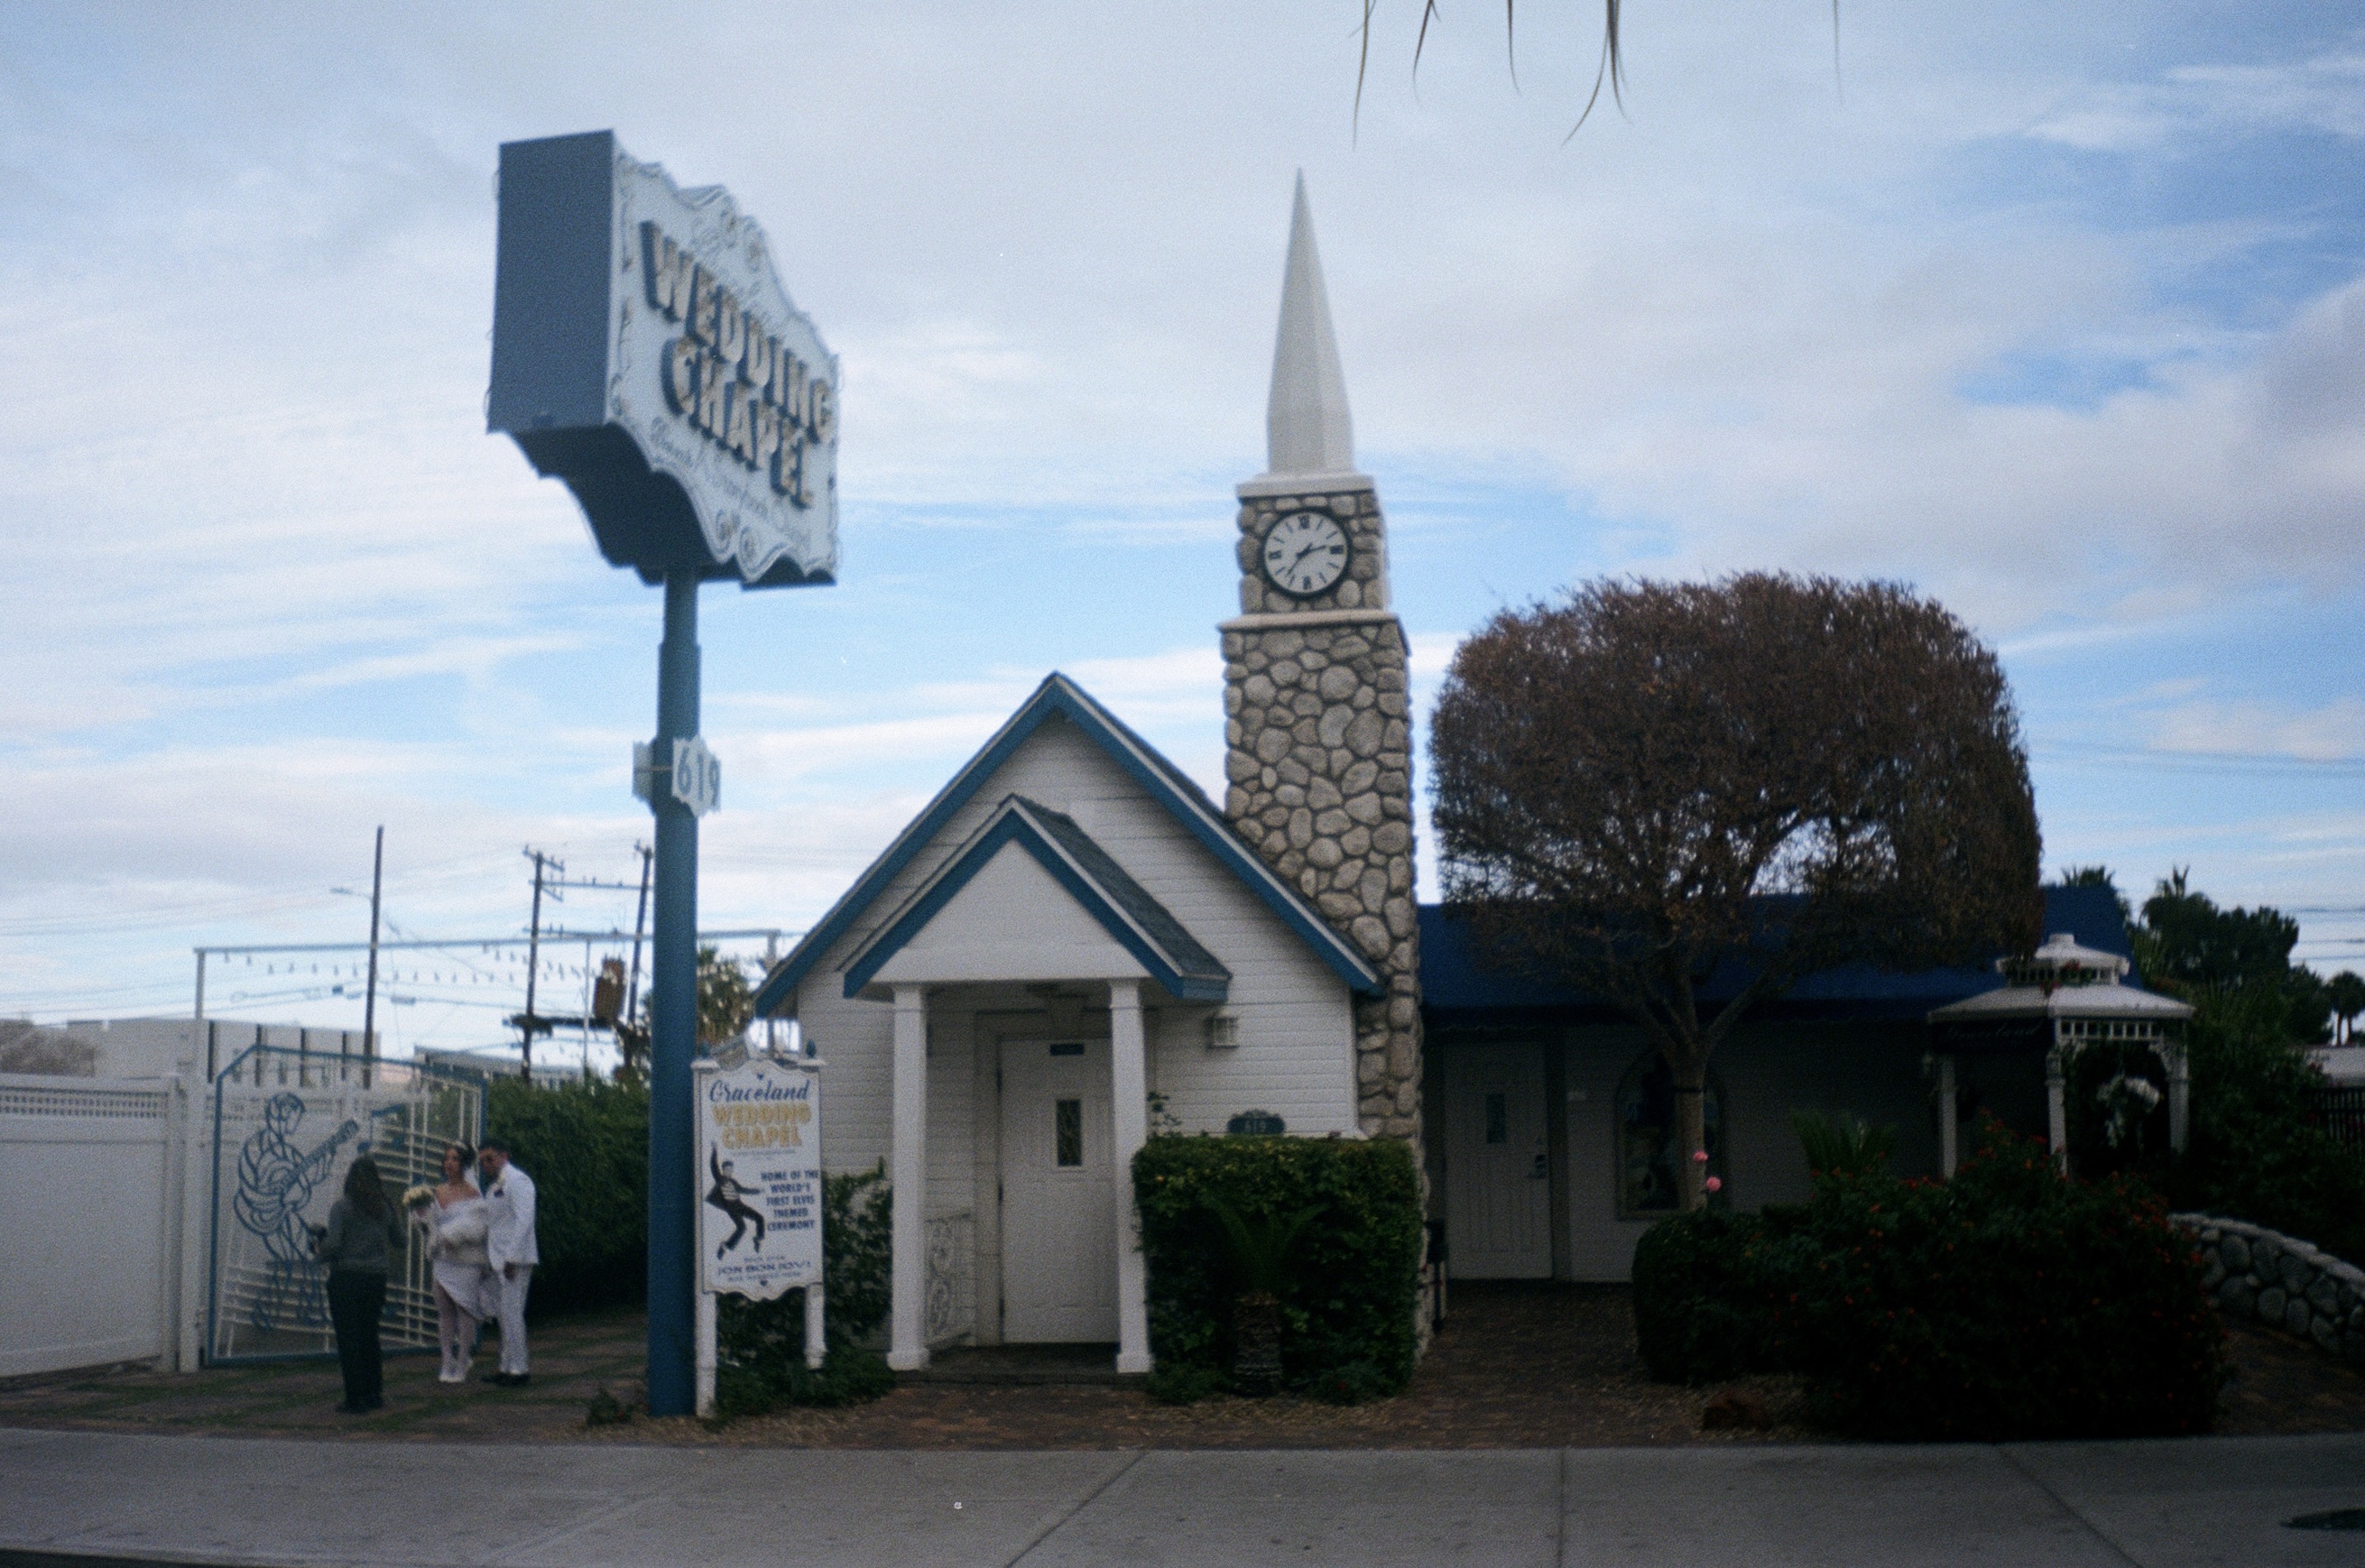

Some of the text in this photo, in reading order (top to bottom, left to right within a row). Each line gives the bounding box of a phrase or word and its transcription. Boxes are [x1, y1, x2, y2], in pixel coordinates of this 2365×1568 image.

[638, 219, 833, 446] WEDDING
[661, 337, 812, 511] CHAPEL
[678, 745, 720, 807] 619
[709, 1079, 810, 1102] Graceland
[713, 1102, 811, 1125] WEDDING
[723, 1126, 802, 1148] CHAPEL
[761, 1169, 818, 1182] HOME OF THE
[766, 1194, 815, 1207] FIRST ELVIS
